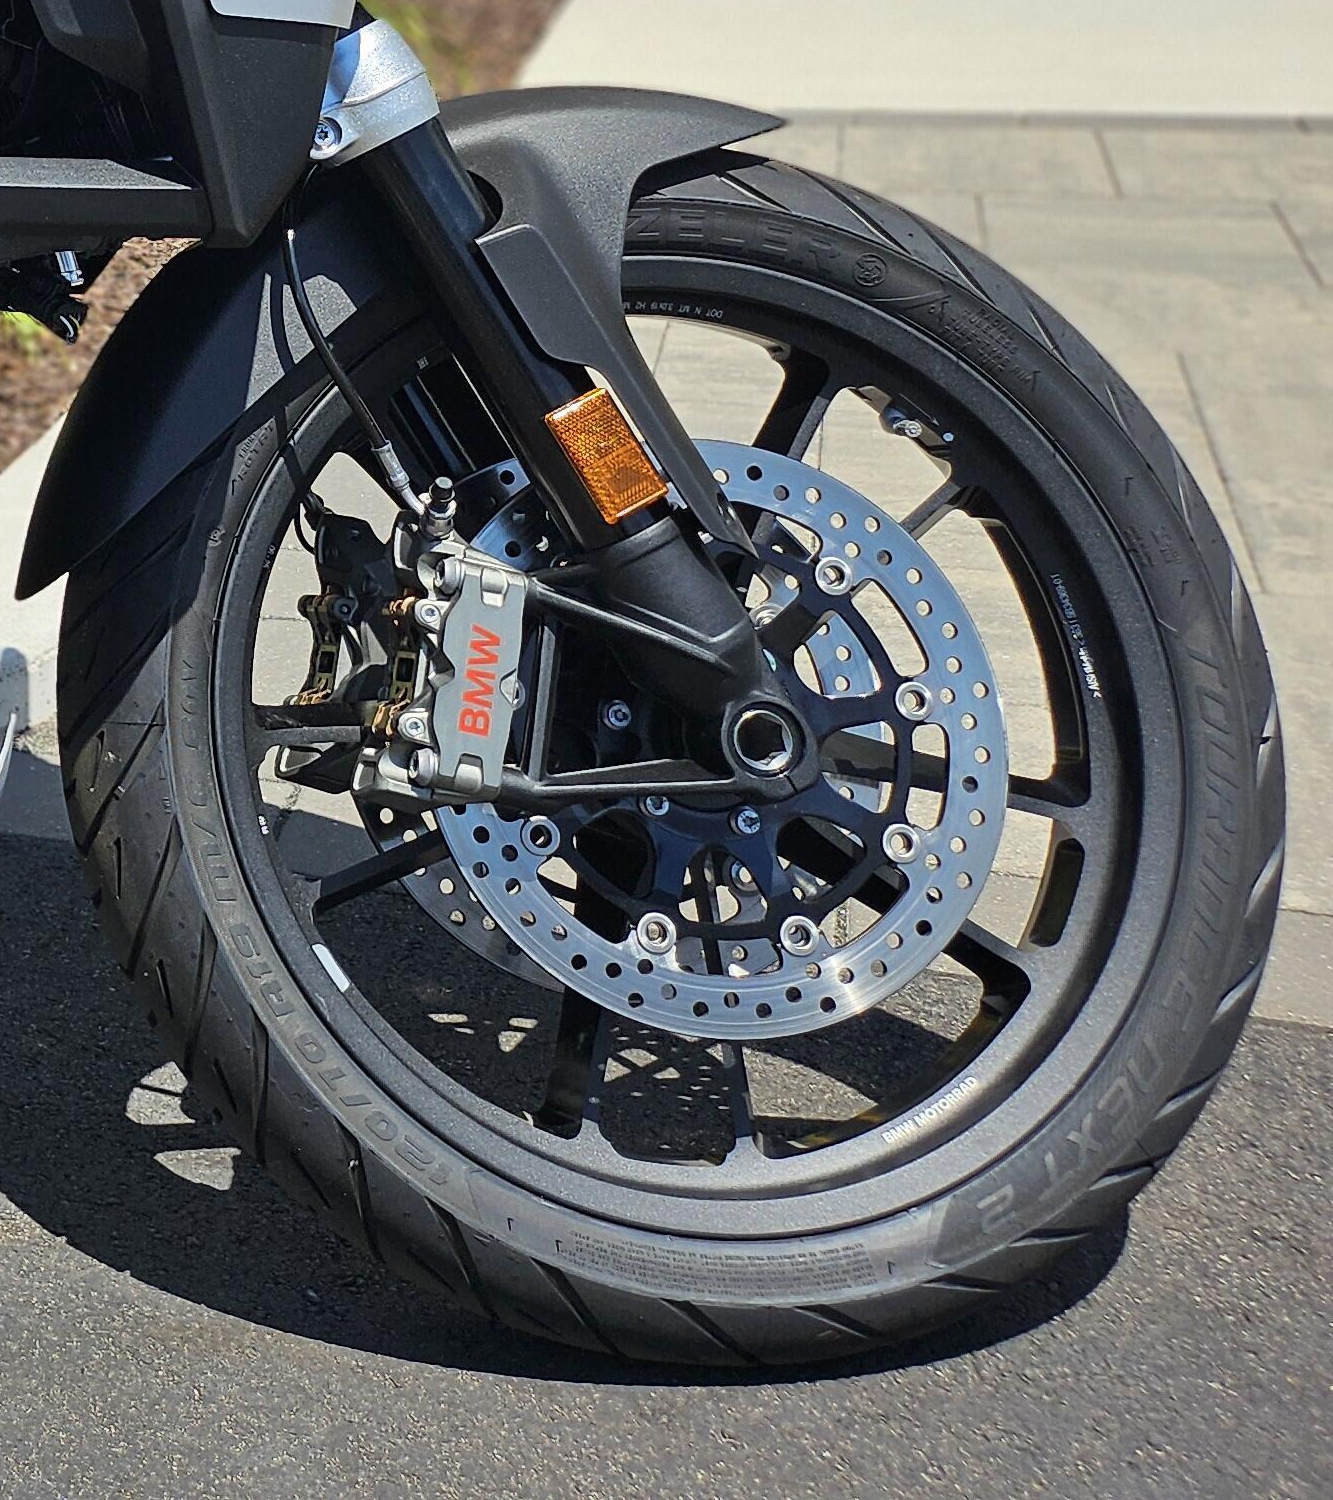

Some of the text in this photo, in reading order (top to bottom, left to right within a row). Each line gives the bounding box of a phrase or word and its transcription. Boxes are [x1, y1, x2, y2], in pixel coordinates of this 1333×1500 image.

[458, 624, 503, 738] BMW
[1171, 640, 1237, 1034] TOURANCE
[294, 1032, 453, 1186] 120/70
[881, 1076, 977, 1144] BMW MOTORRAD
[975, 1184, 1018, 1239] 2
